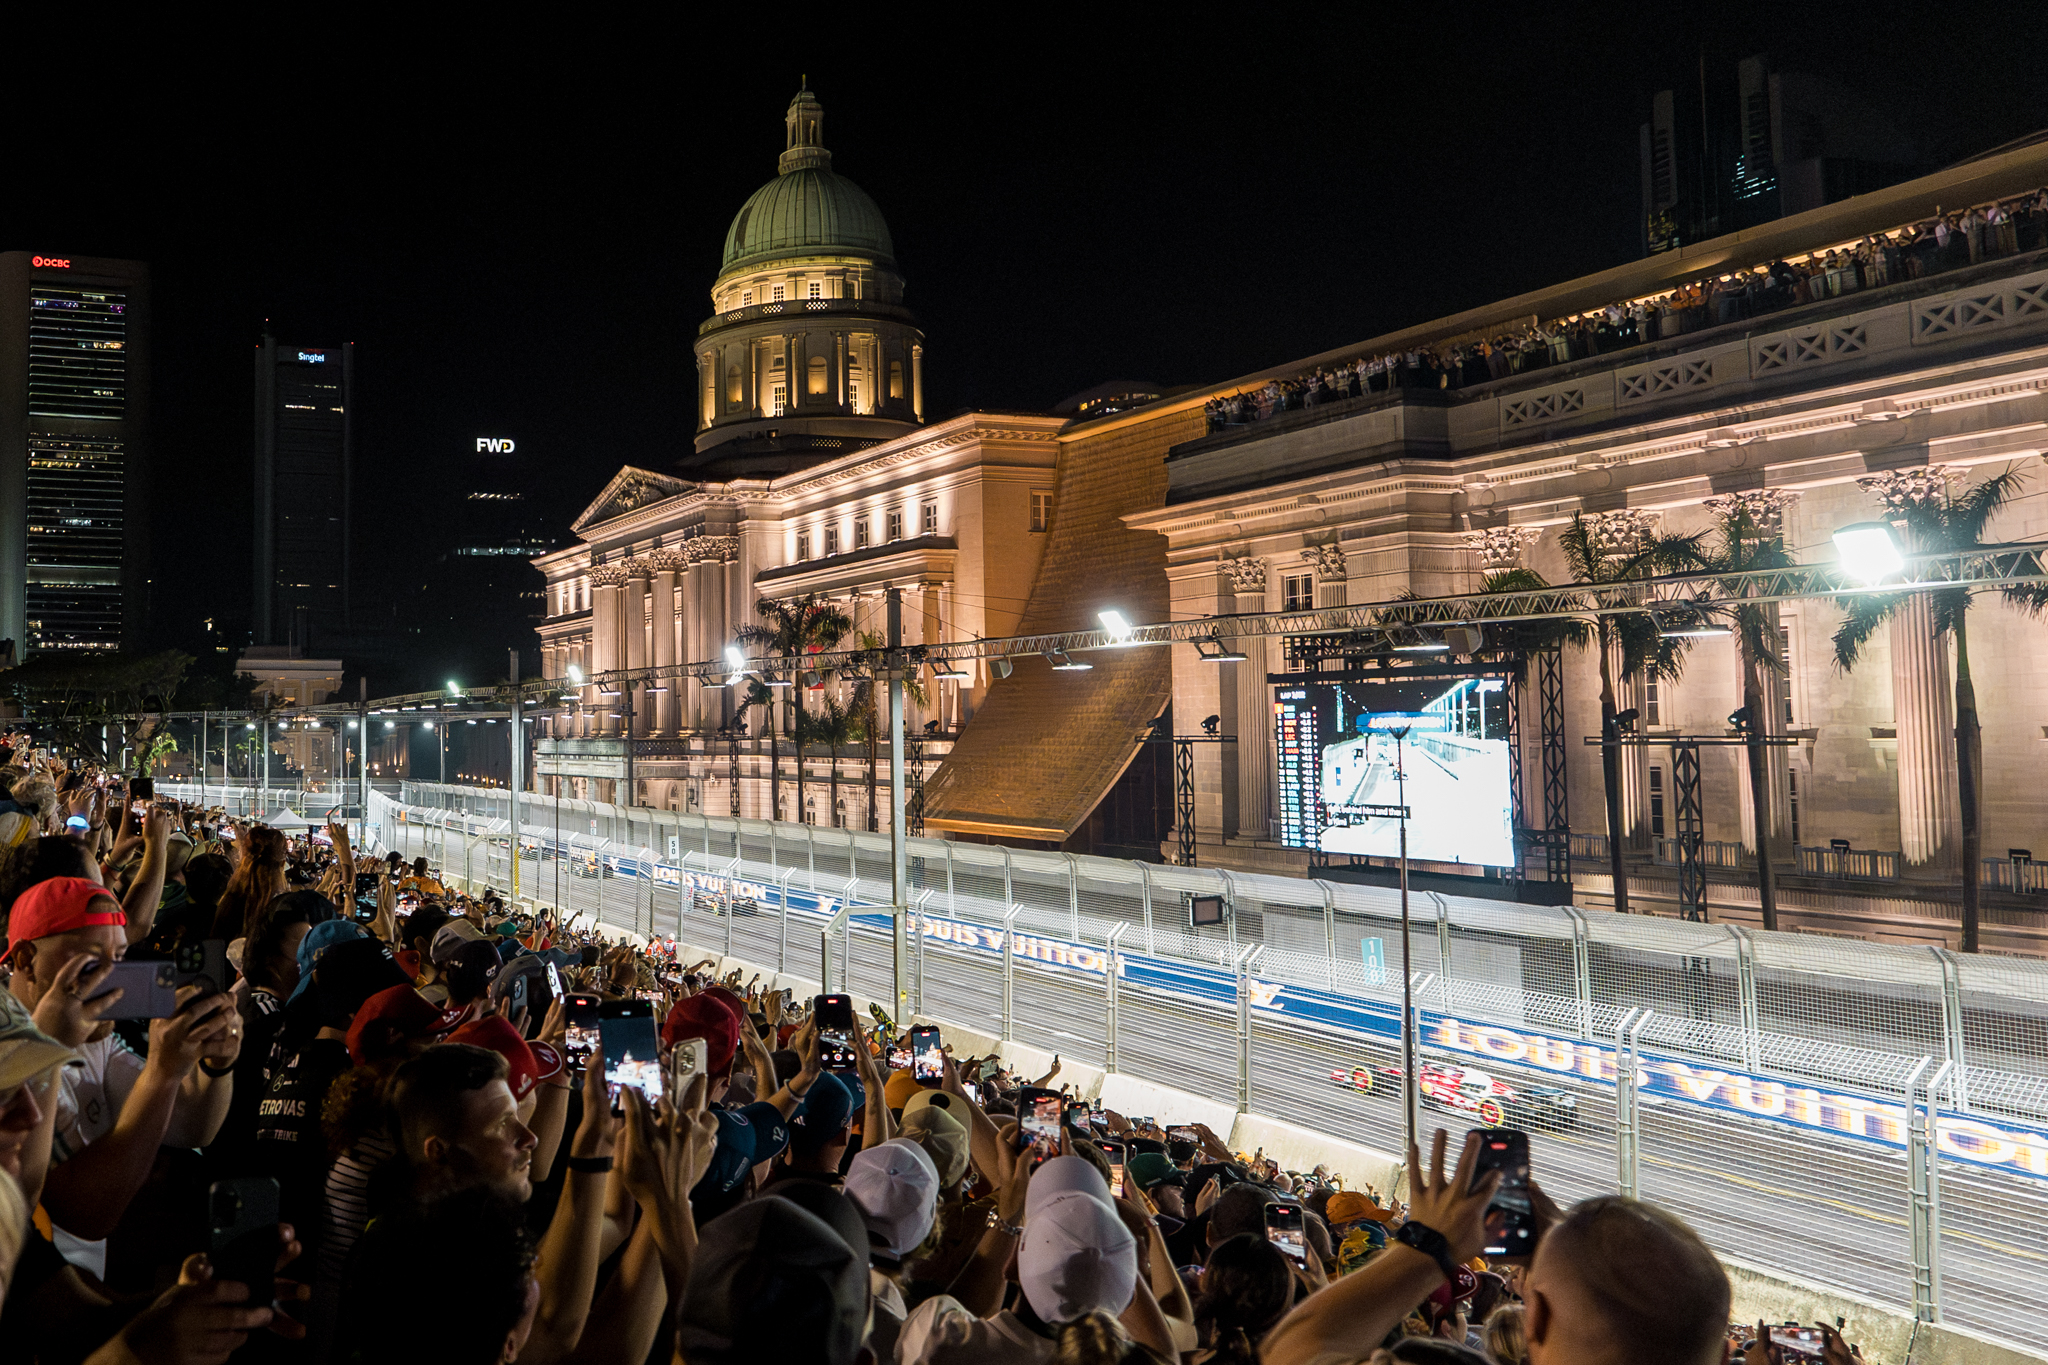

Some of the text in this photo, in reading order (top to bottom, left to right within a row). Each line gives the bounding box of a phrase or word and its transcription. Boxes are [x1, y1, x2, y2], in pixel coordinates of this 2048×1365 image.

[44, 258, 70, 268] OCBC
[298, 352, 325, 363] Singtel
[477, 438, 515, 453] FWD
[259, 1099, 306, 1117] ETROAS
[772, 1125, 784, 1142] 12
